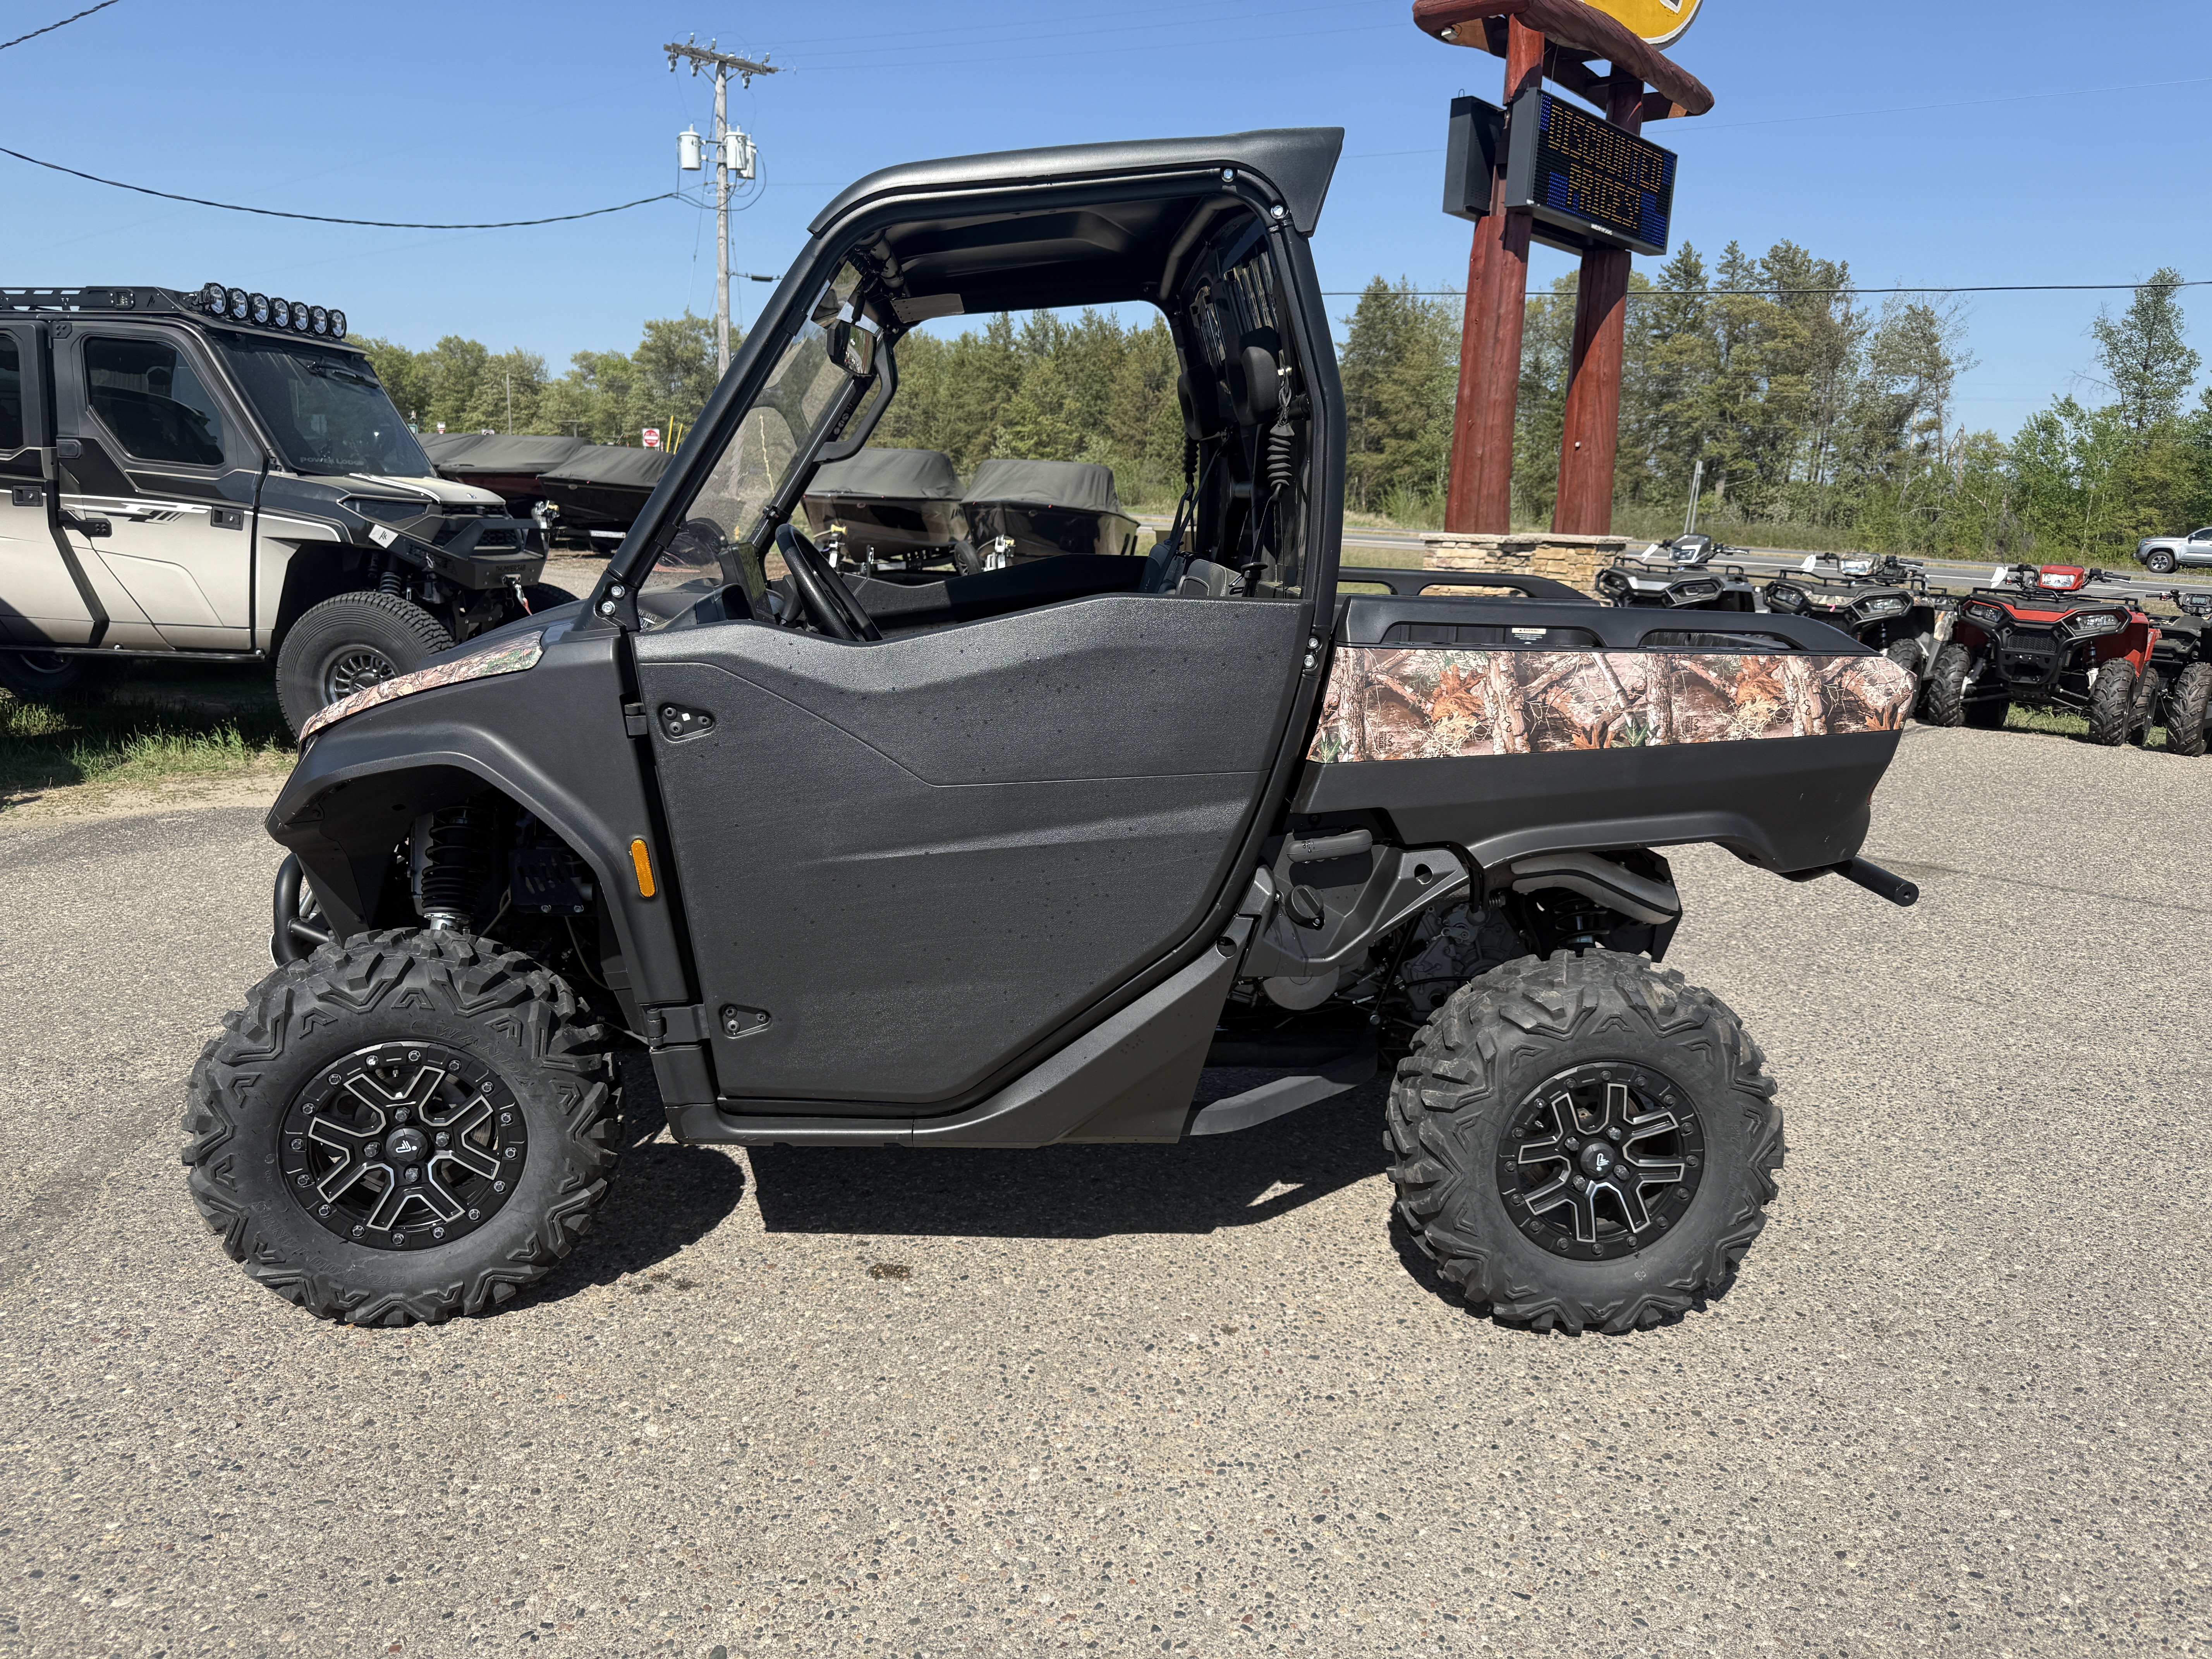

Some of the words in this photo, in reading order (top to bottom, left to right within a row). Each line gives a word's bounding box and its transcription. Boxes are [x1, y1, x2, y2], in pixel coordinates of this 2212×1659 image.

[1548, 104, 1663, 192] DISCOUNTED
[1567, 163, 1641, 229] PRICES
[435, 1024, 535, 1089] WANDA
